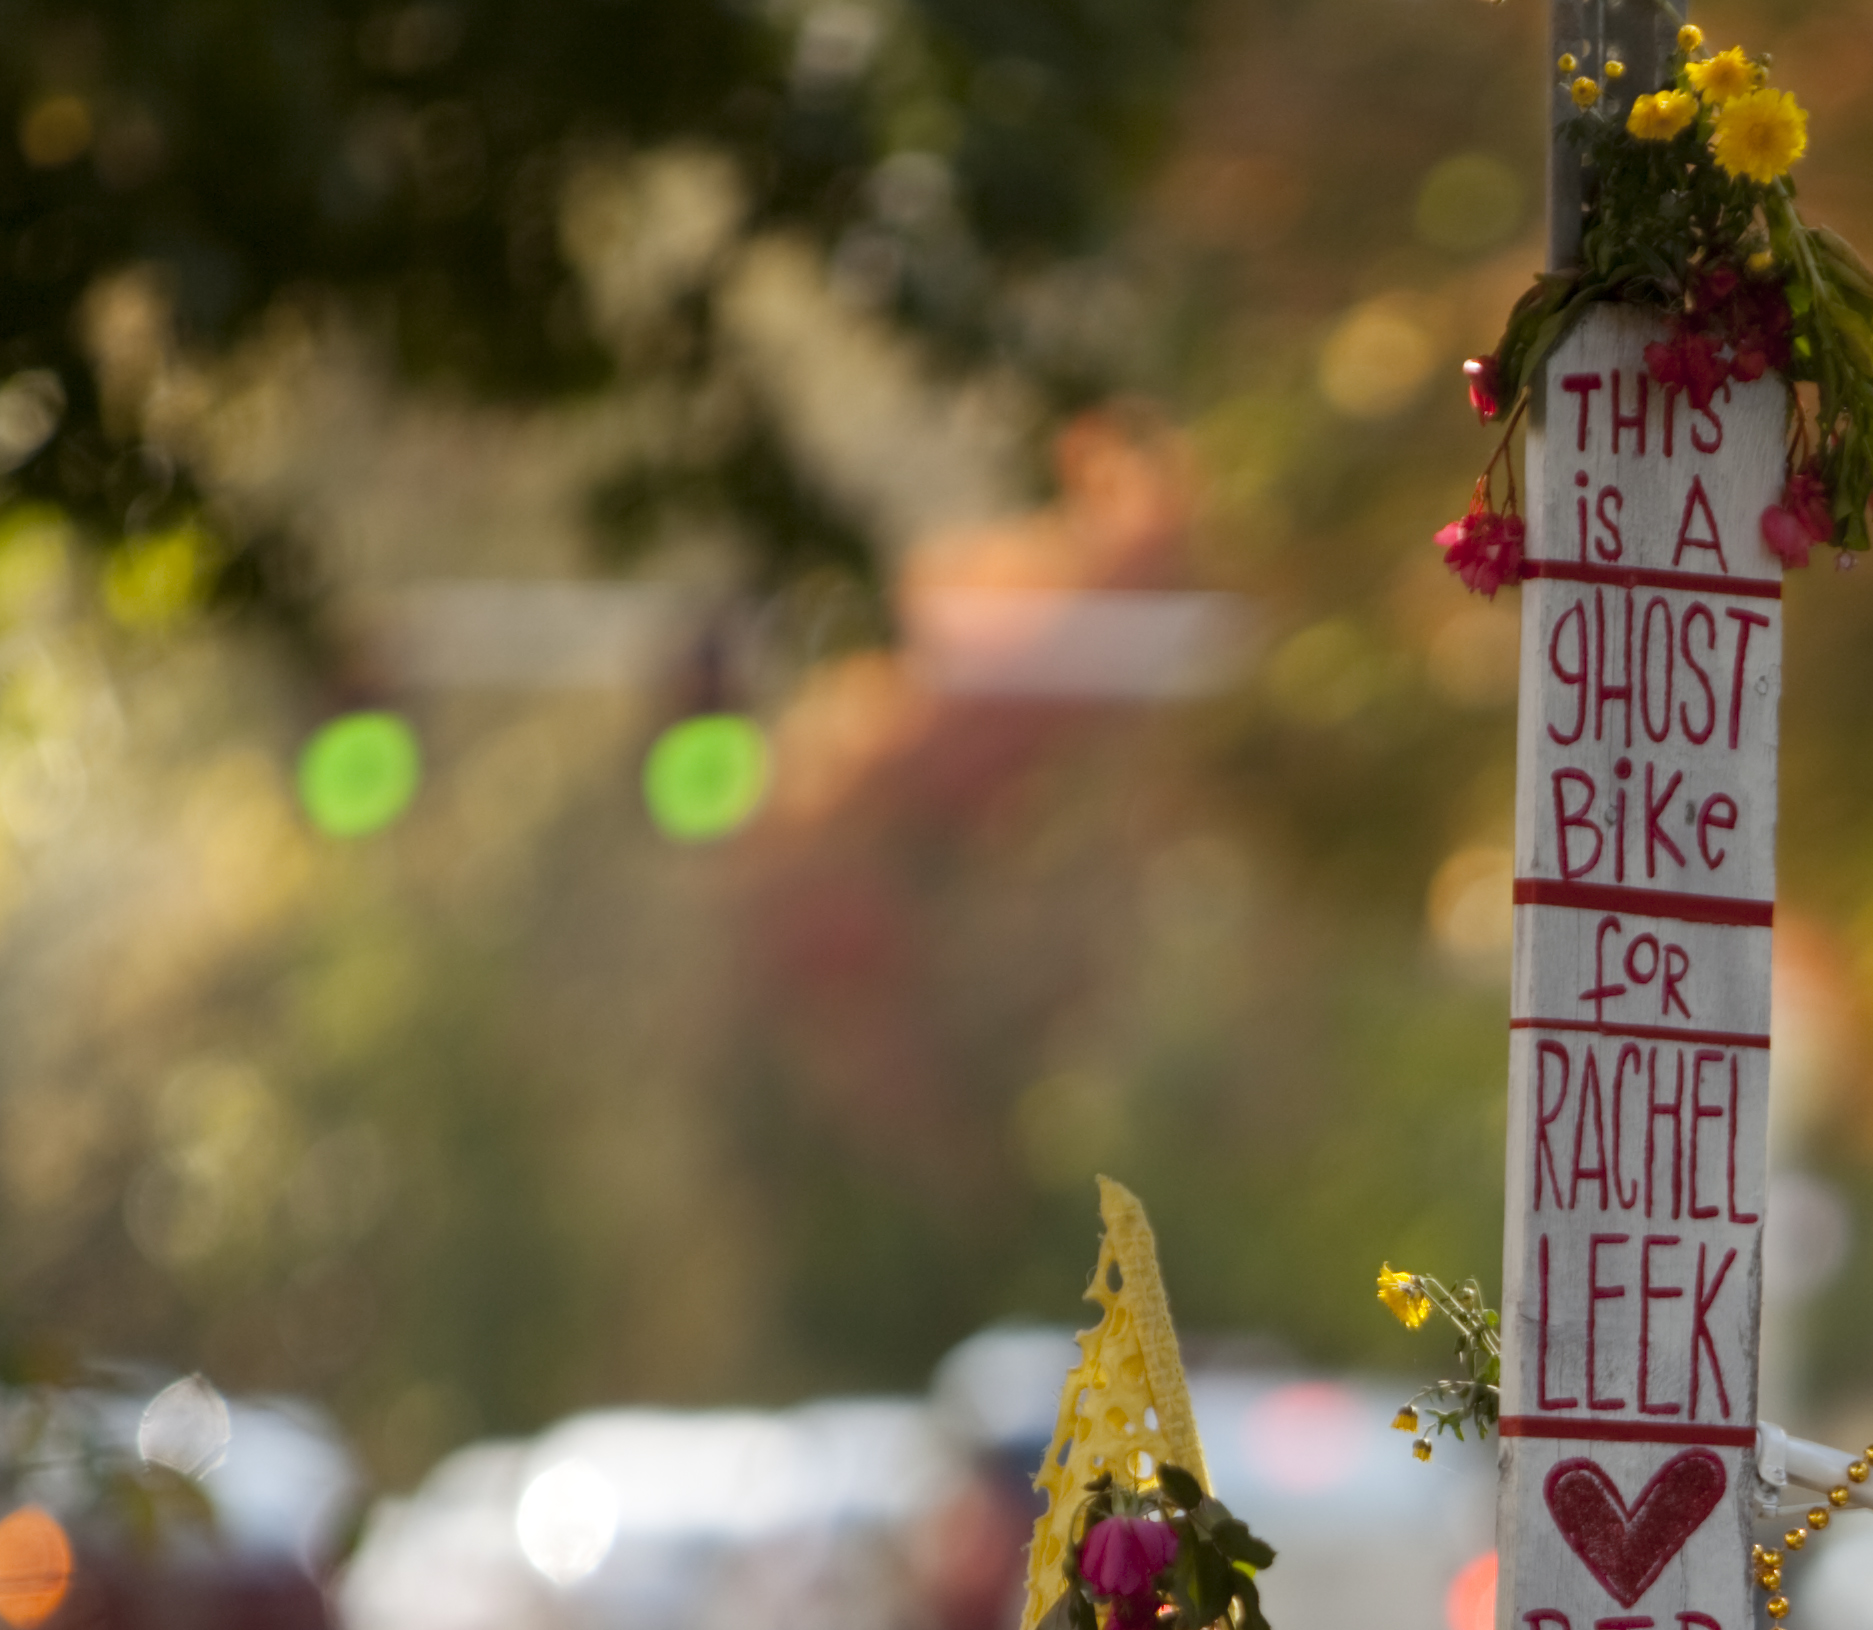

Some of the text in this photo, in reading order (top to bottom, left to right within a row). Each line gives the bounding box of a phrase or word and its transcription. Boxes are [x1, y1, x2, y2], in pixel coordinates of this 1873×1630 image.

[1561, 369, 1731, 457] THIS
[1673, 475, 1728, 573] A
[1534, 1039, 1758, 1223] RACHEL
[1537, 1232, 1737, 1420] LEEK
